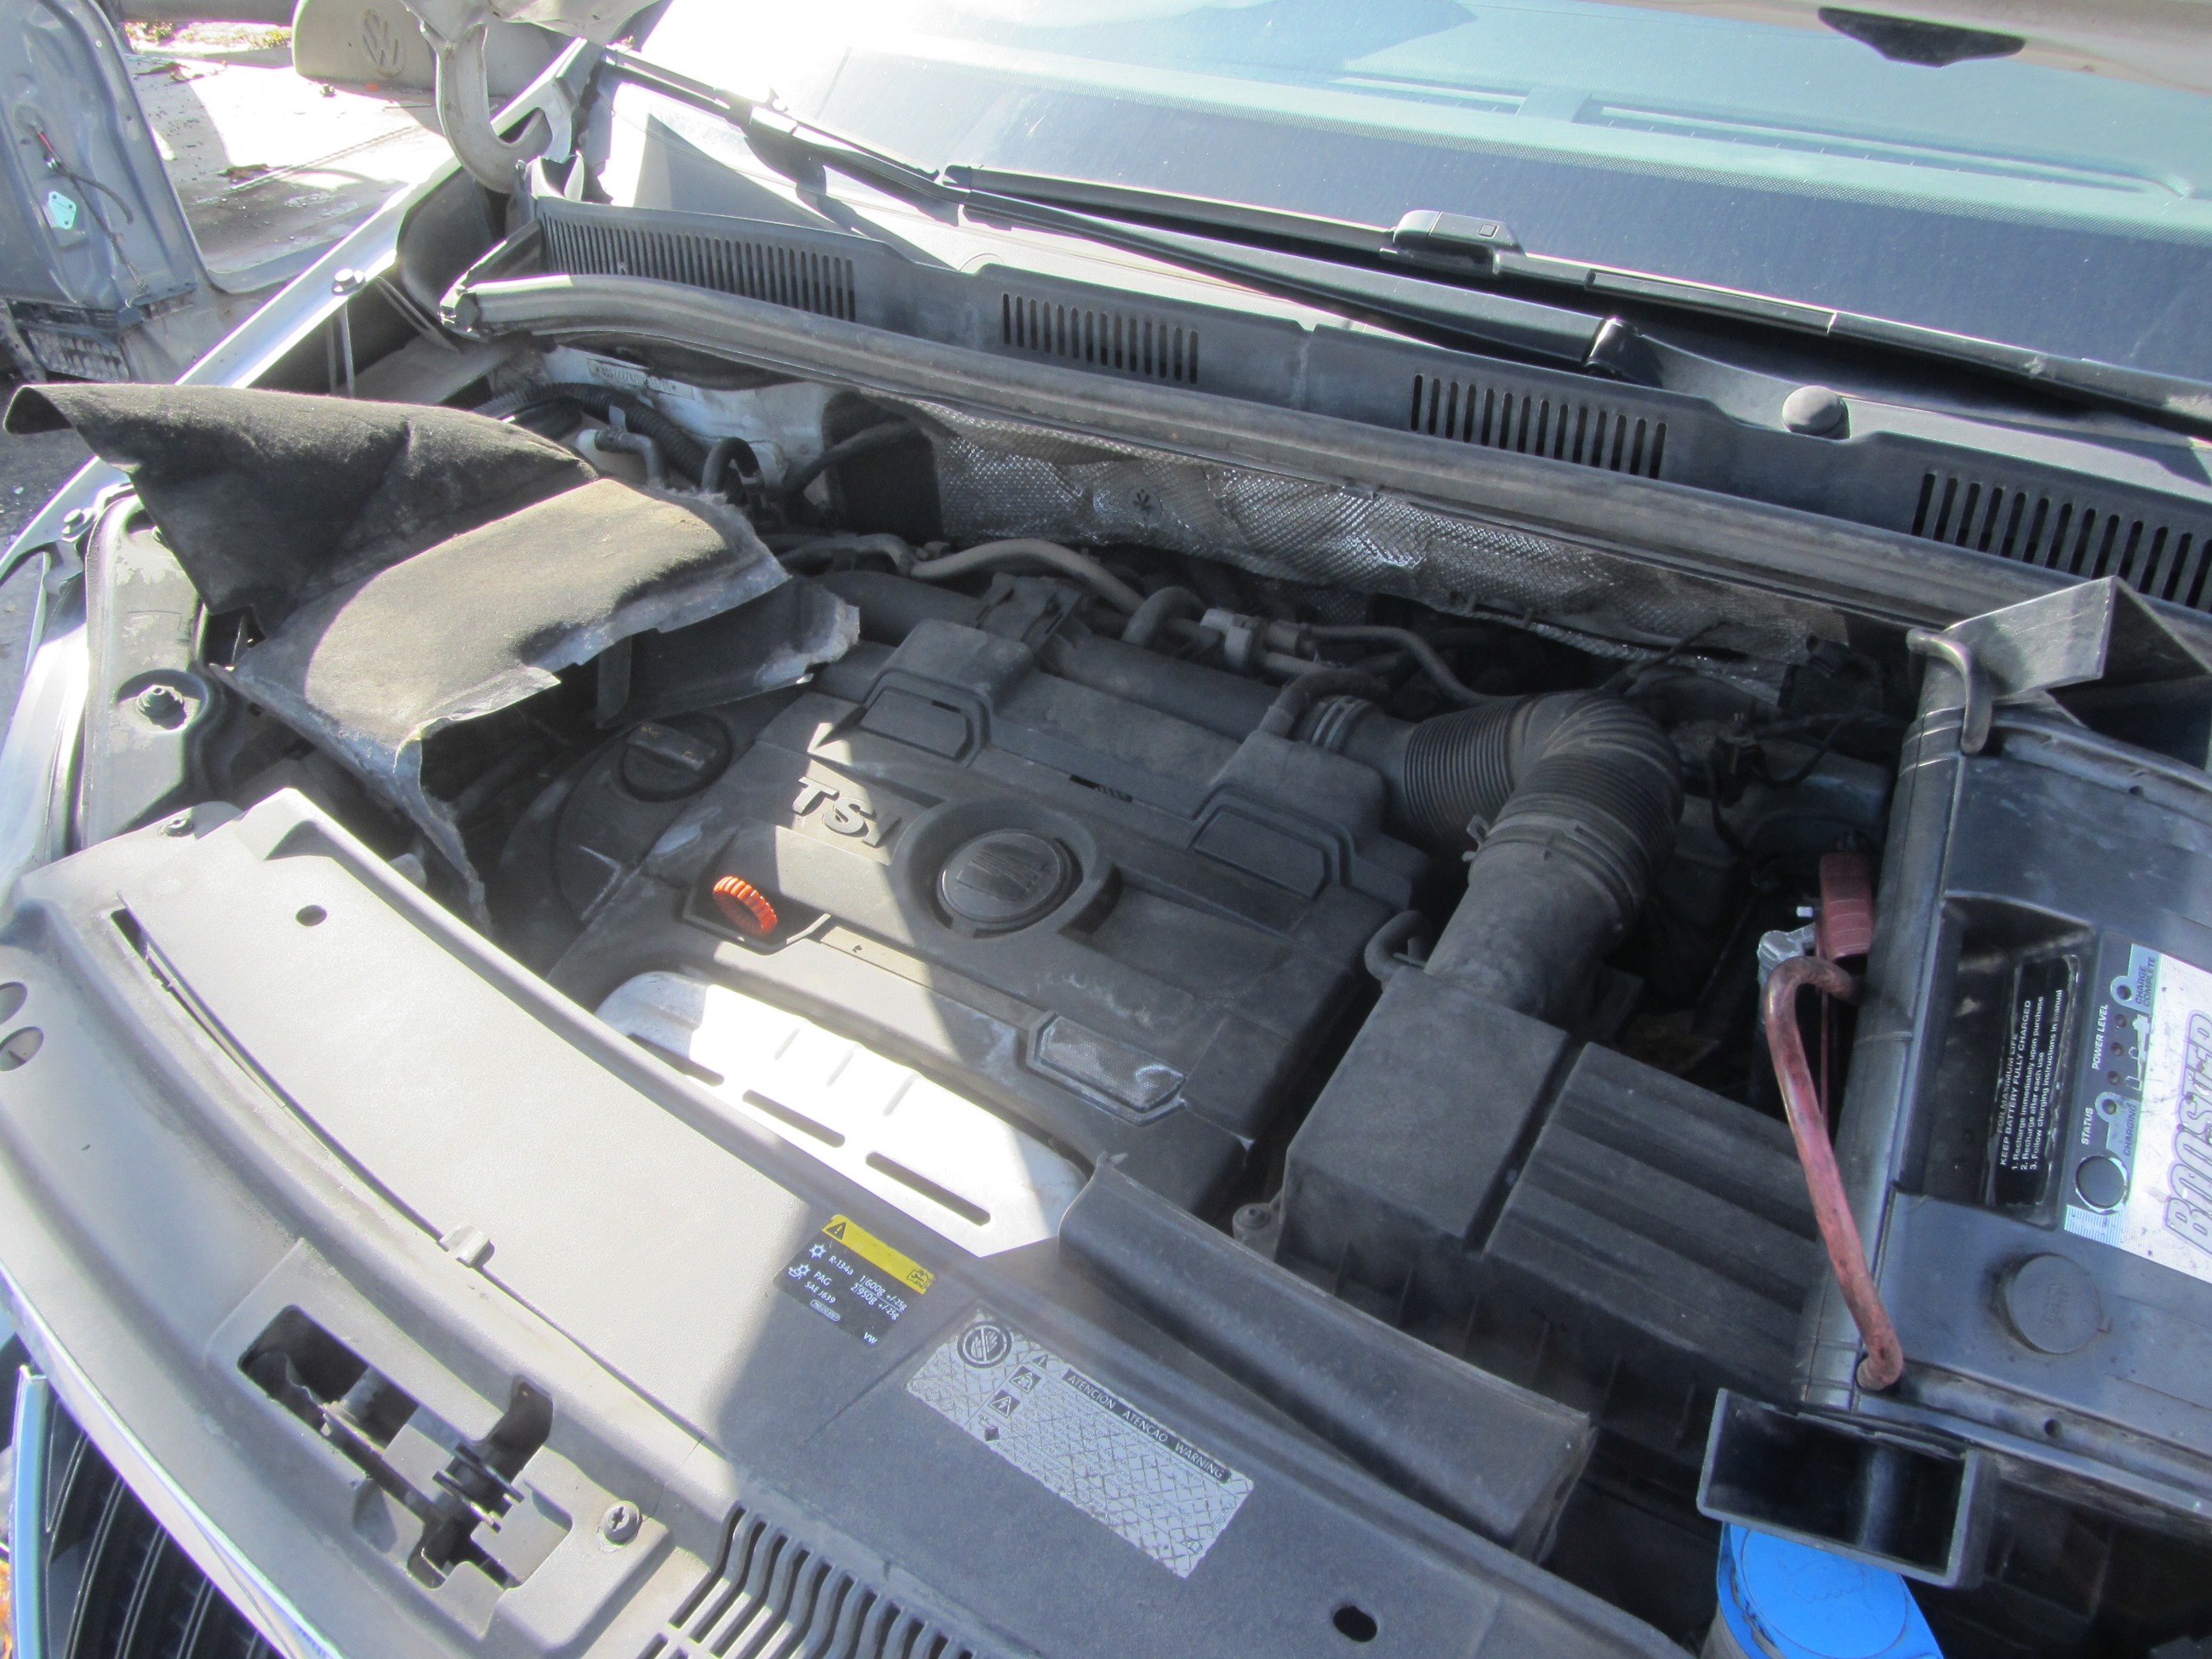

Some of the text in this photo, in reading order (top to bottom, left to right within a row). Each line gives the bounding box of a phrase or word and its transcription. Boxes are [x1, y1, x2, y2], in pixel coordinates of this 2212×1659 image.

[792, 777, 901, 847] TSI
[2135, 965, 2146, 1004] CHARGE
[2141, 956, 2156, 1006] COMPLETE
[2091, 1003, 2107, 1069] POWER LEVEL
[1999, 999, 2031, 1165] KEEP BATTERY FULLY CHARGED
[2000, 1057, 2013, 1109] MAXIMUM
[2010, 995, 2044, 1170] 1. Recharge immediately upon purchase
[2029, 989, 2062, 1170] 3. Follow charging instructions in manual
[2020, 1052, 2044, 1170] 2. Recharge after each use
[2080, 1106, 2093, 1145] STATUS
[2122, 1103, 2136, 1155] CHARGING
[812, 1270, 832, 1286] PAG
[828, 1254, 855, 1275] R-134a
[803, 1280, 836, 1304] SAE J639
[862, 1331, 878, 1344] VW
[1172, 1440, 1225, 1479] WARNING
